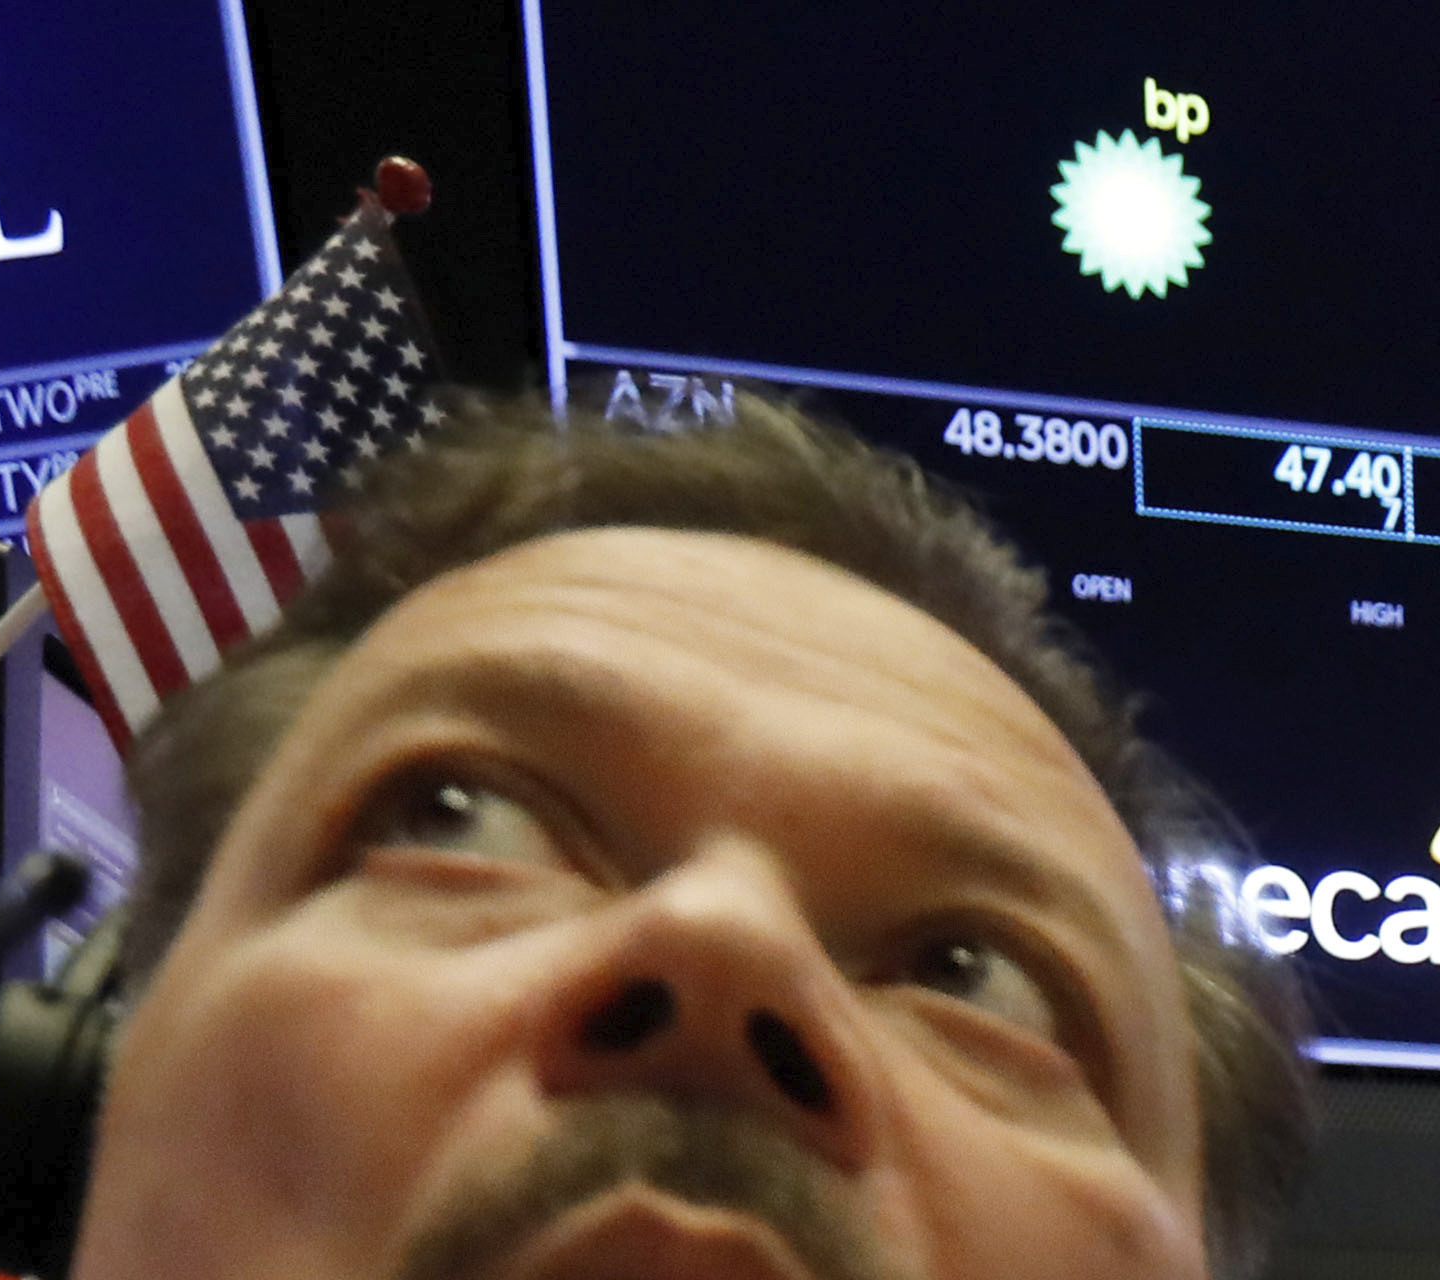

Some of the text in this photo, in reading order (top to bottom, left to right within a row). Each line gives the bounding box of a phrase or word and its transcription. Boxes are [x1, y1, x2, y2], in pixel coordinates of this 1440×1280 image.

[1144, 76, 1210, 143] bp
[942, 407, 1130, 472] 48.3800
[1273, 444, 1402, 501] 47.40
[1072, 572, 1132, 604] OPEN
[1351, 599, 1404, 628] HIGH
